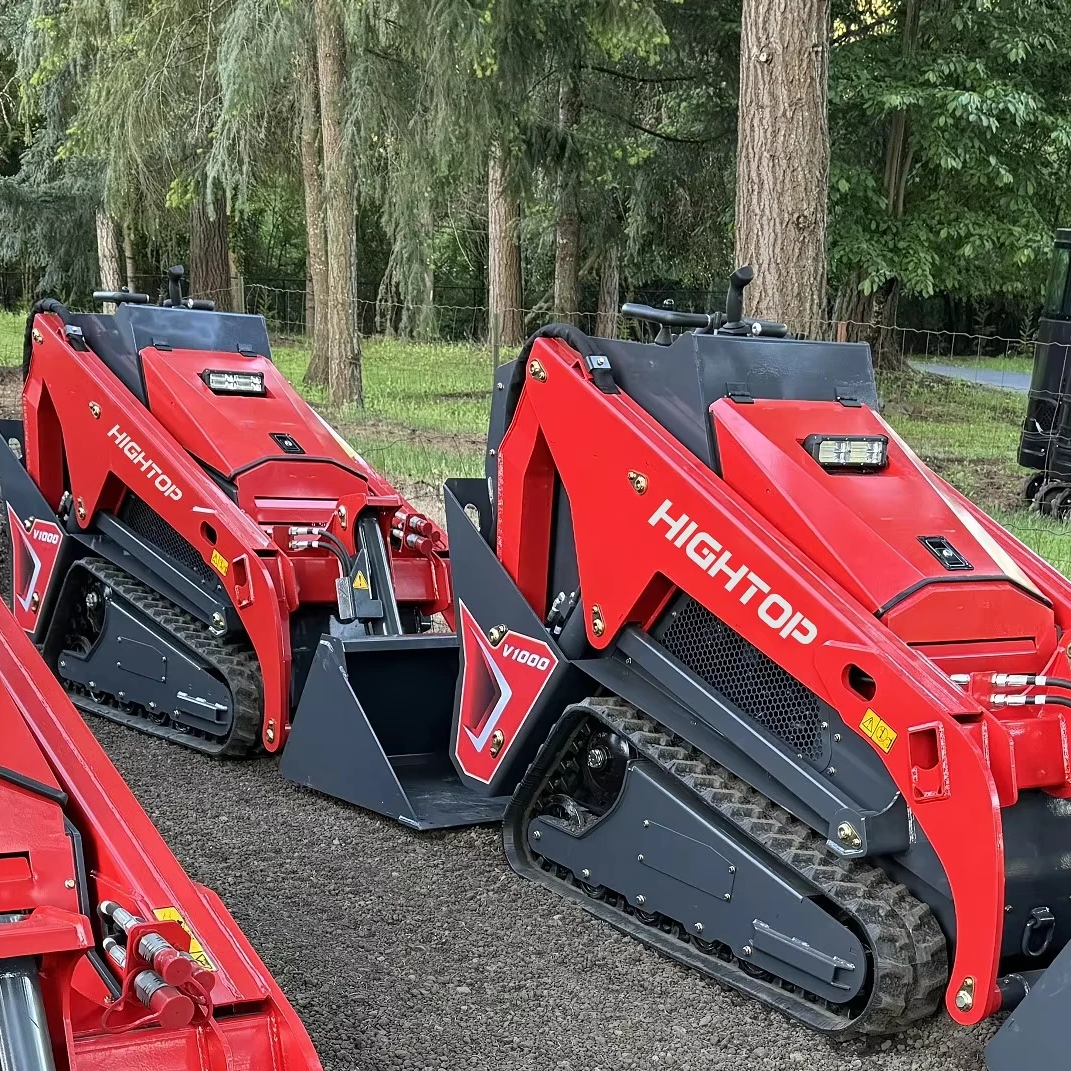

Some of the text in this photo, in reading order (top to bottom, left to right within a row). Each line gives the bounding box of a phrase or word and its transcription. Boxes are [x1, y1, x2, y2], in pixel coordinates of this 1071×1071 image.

[107, 423, 183, 501] HIGHTOP
[33, 529, 59, 545] V1000
[647, 498, 818, 645] HIGHTOP
[502, 643, 551, 671] V1000
